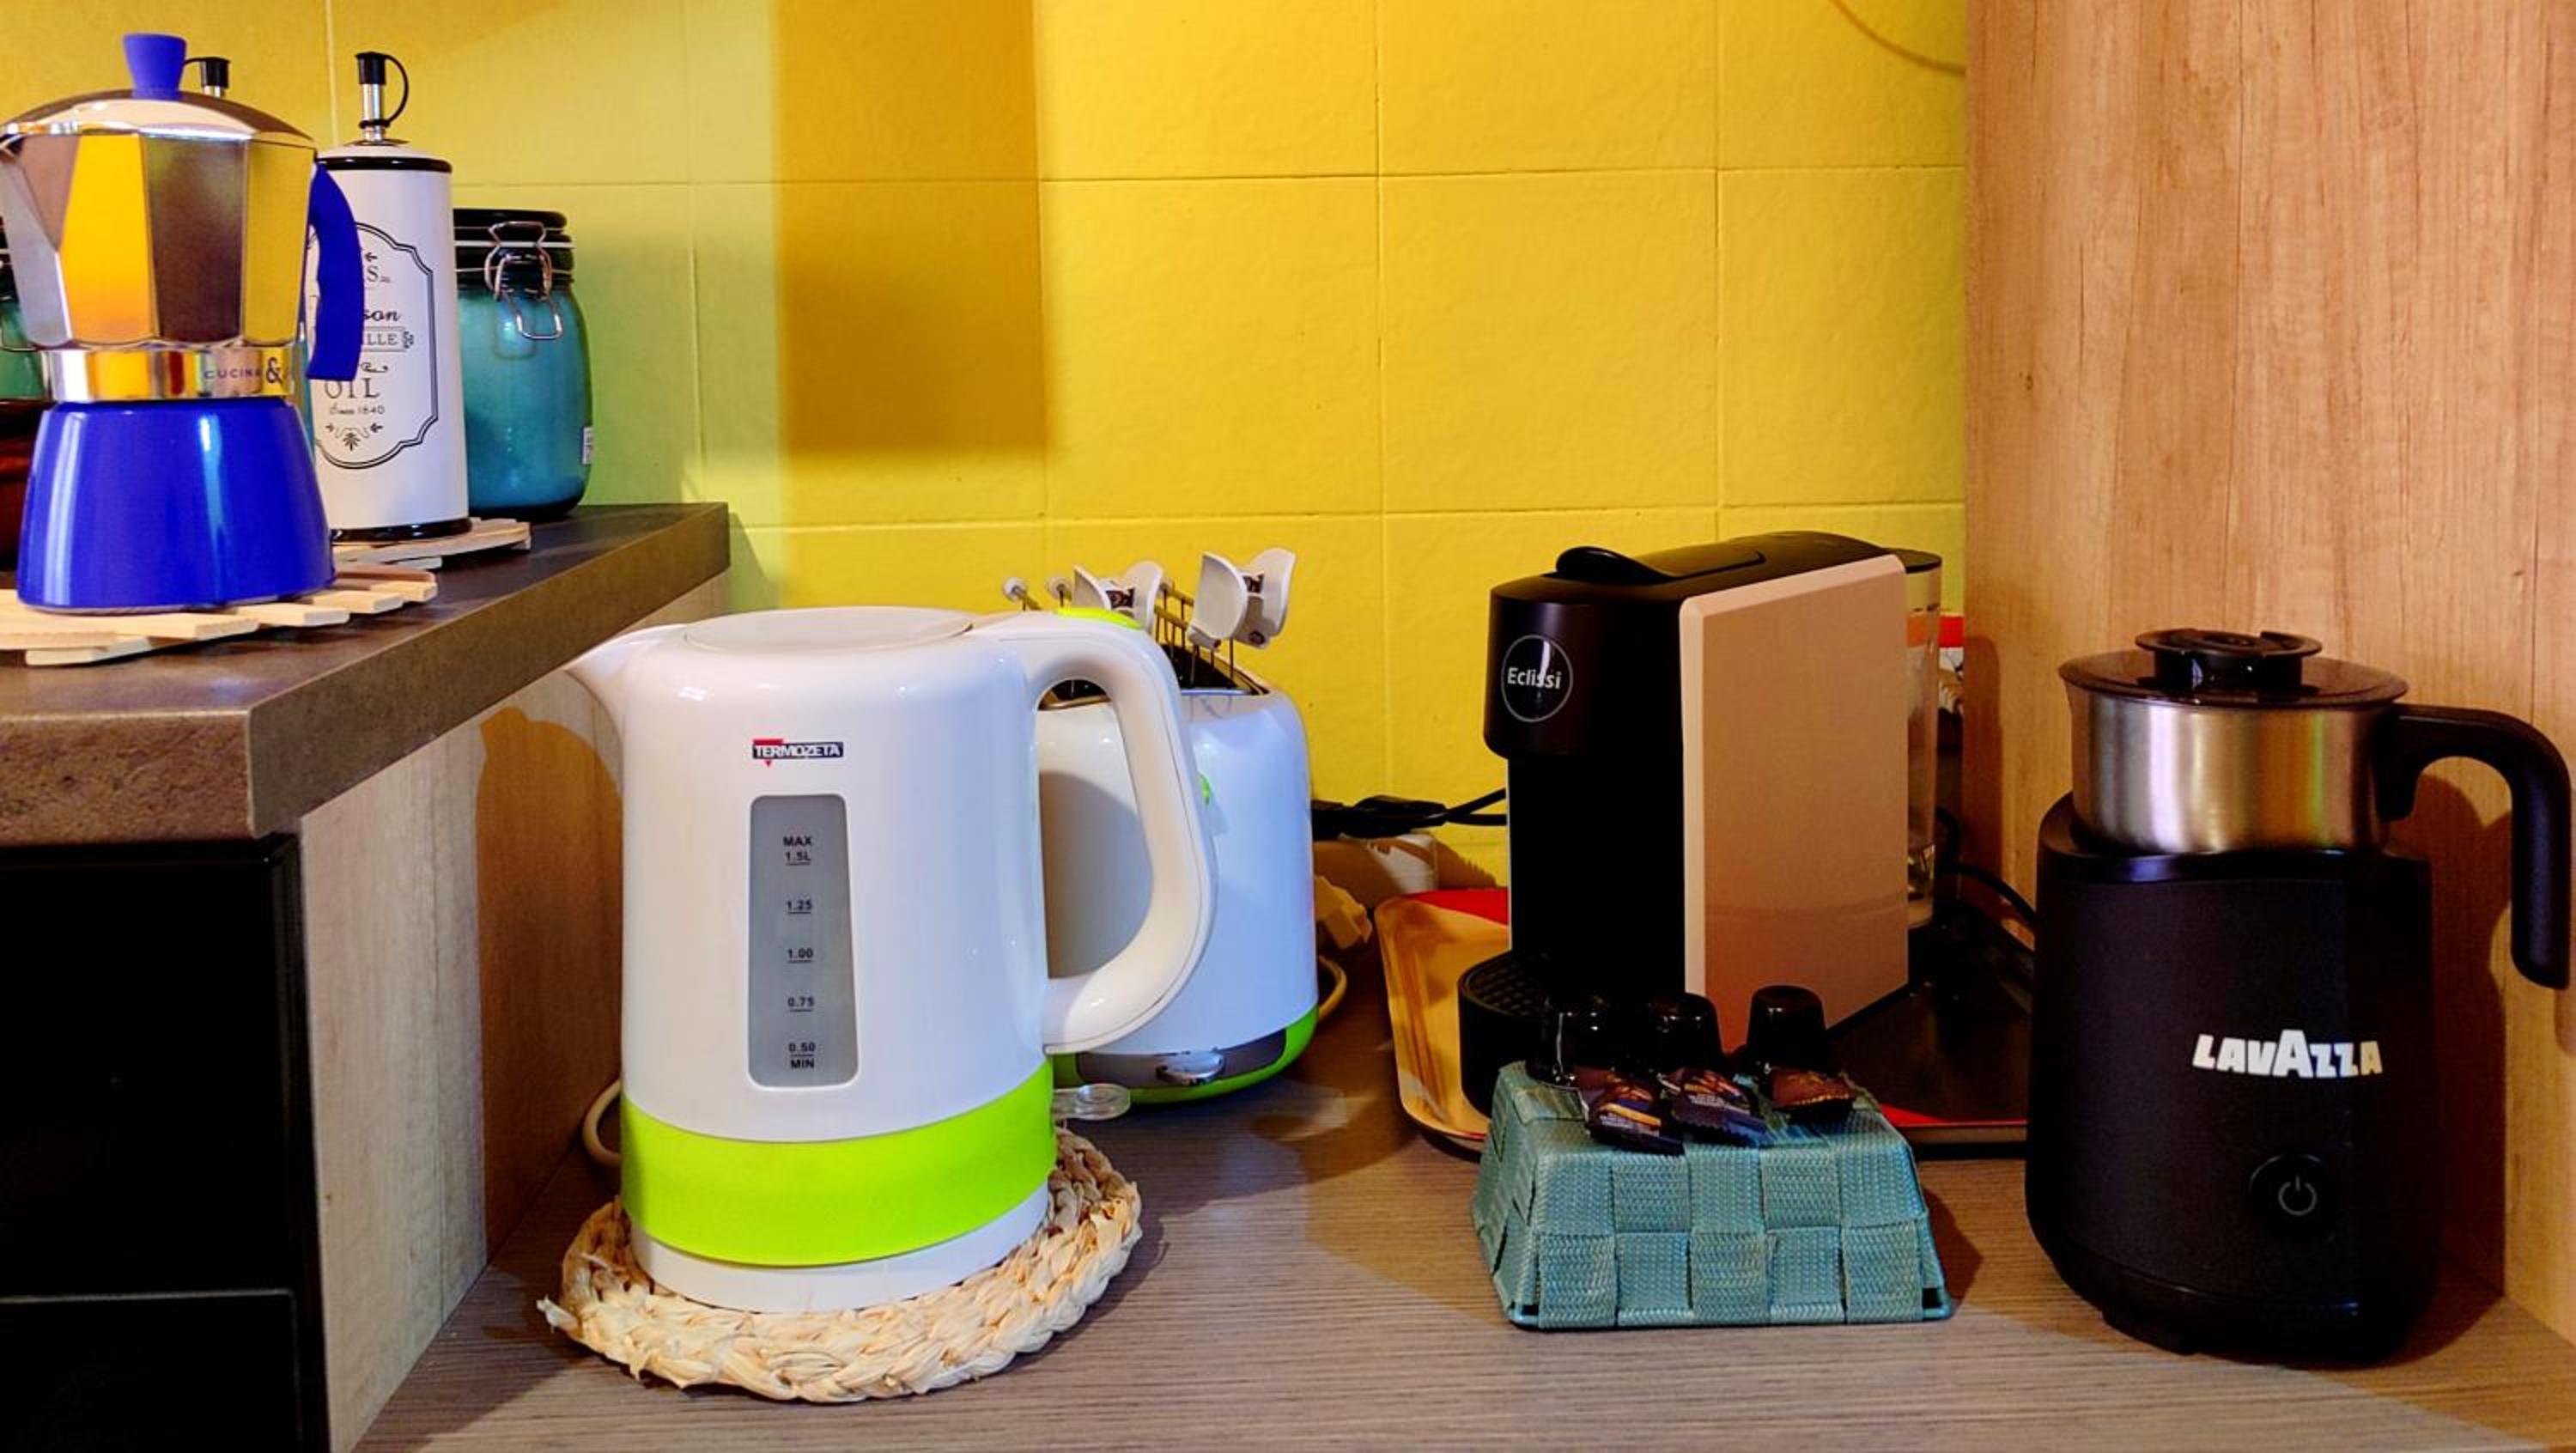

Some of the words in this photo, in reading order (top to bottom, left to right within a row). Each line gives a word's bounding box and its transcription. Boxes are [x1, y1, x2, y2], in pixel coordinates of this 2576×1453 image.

[266, 356, 283, 385] &
[324, 378, 380, 398] OIL
[1507, 667, 1562, 690] Eclissi
[755, 744, 841, 757] TERMOZETA
[783, 836, 812, 847] MAX
[785, 851, 811, 861] 1.5L
[785, 899, 812, 910] 1.25
[787, 948, 813, 958] 1.00
[787, 997, 814, 1007] 0.75
[788, 1042, 816, 1052] 0.50
[2192, 1029, 2383, 1079] LAVAZZA
[790, 1059, 815, 1068] MIN
